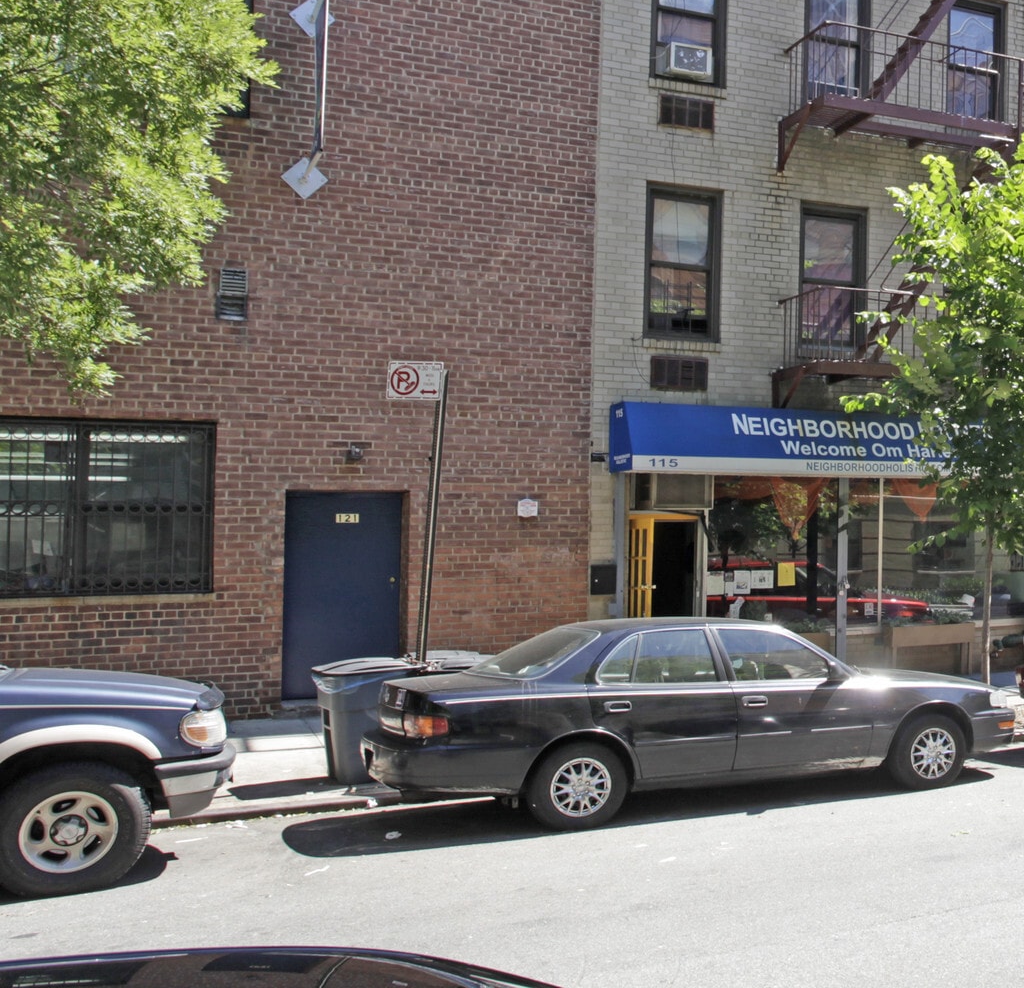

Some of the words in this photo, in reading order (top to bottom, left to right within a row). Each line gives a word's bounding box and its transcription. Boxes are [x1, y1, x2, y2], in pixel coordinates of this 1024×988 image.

[731, 413, 915, 441] NEIGHBORHOOD
[780, 440, 867, 457] Welcome
[871, 443, 904, 458] Om
[649, 458, 679, 468] 115
[338, 514, 357, 523] 121
